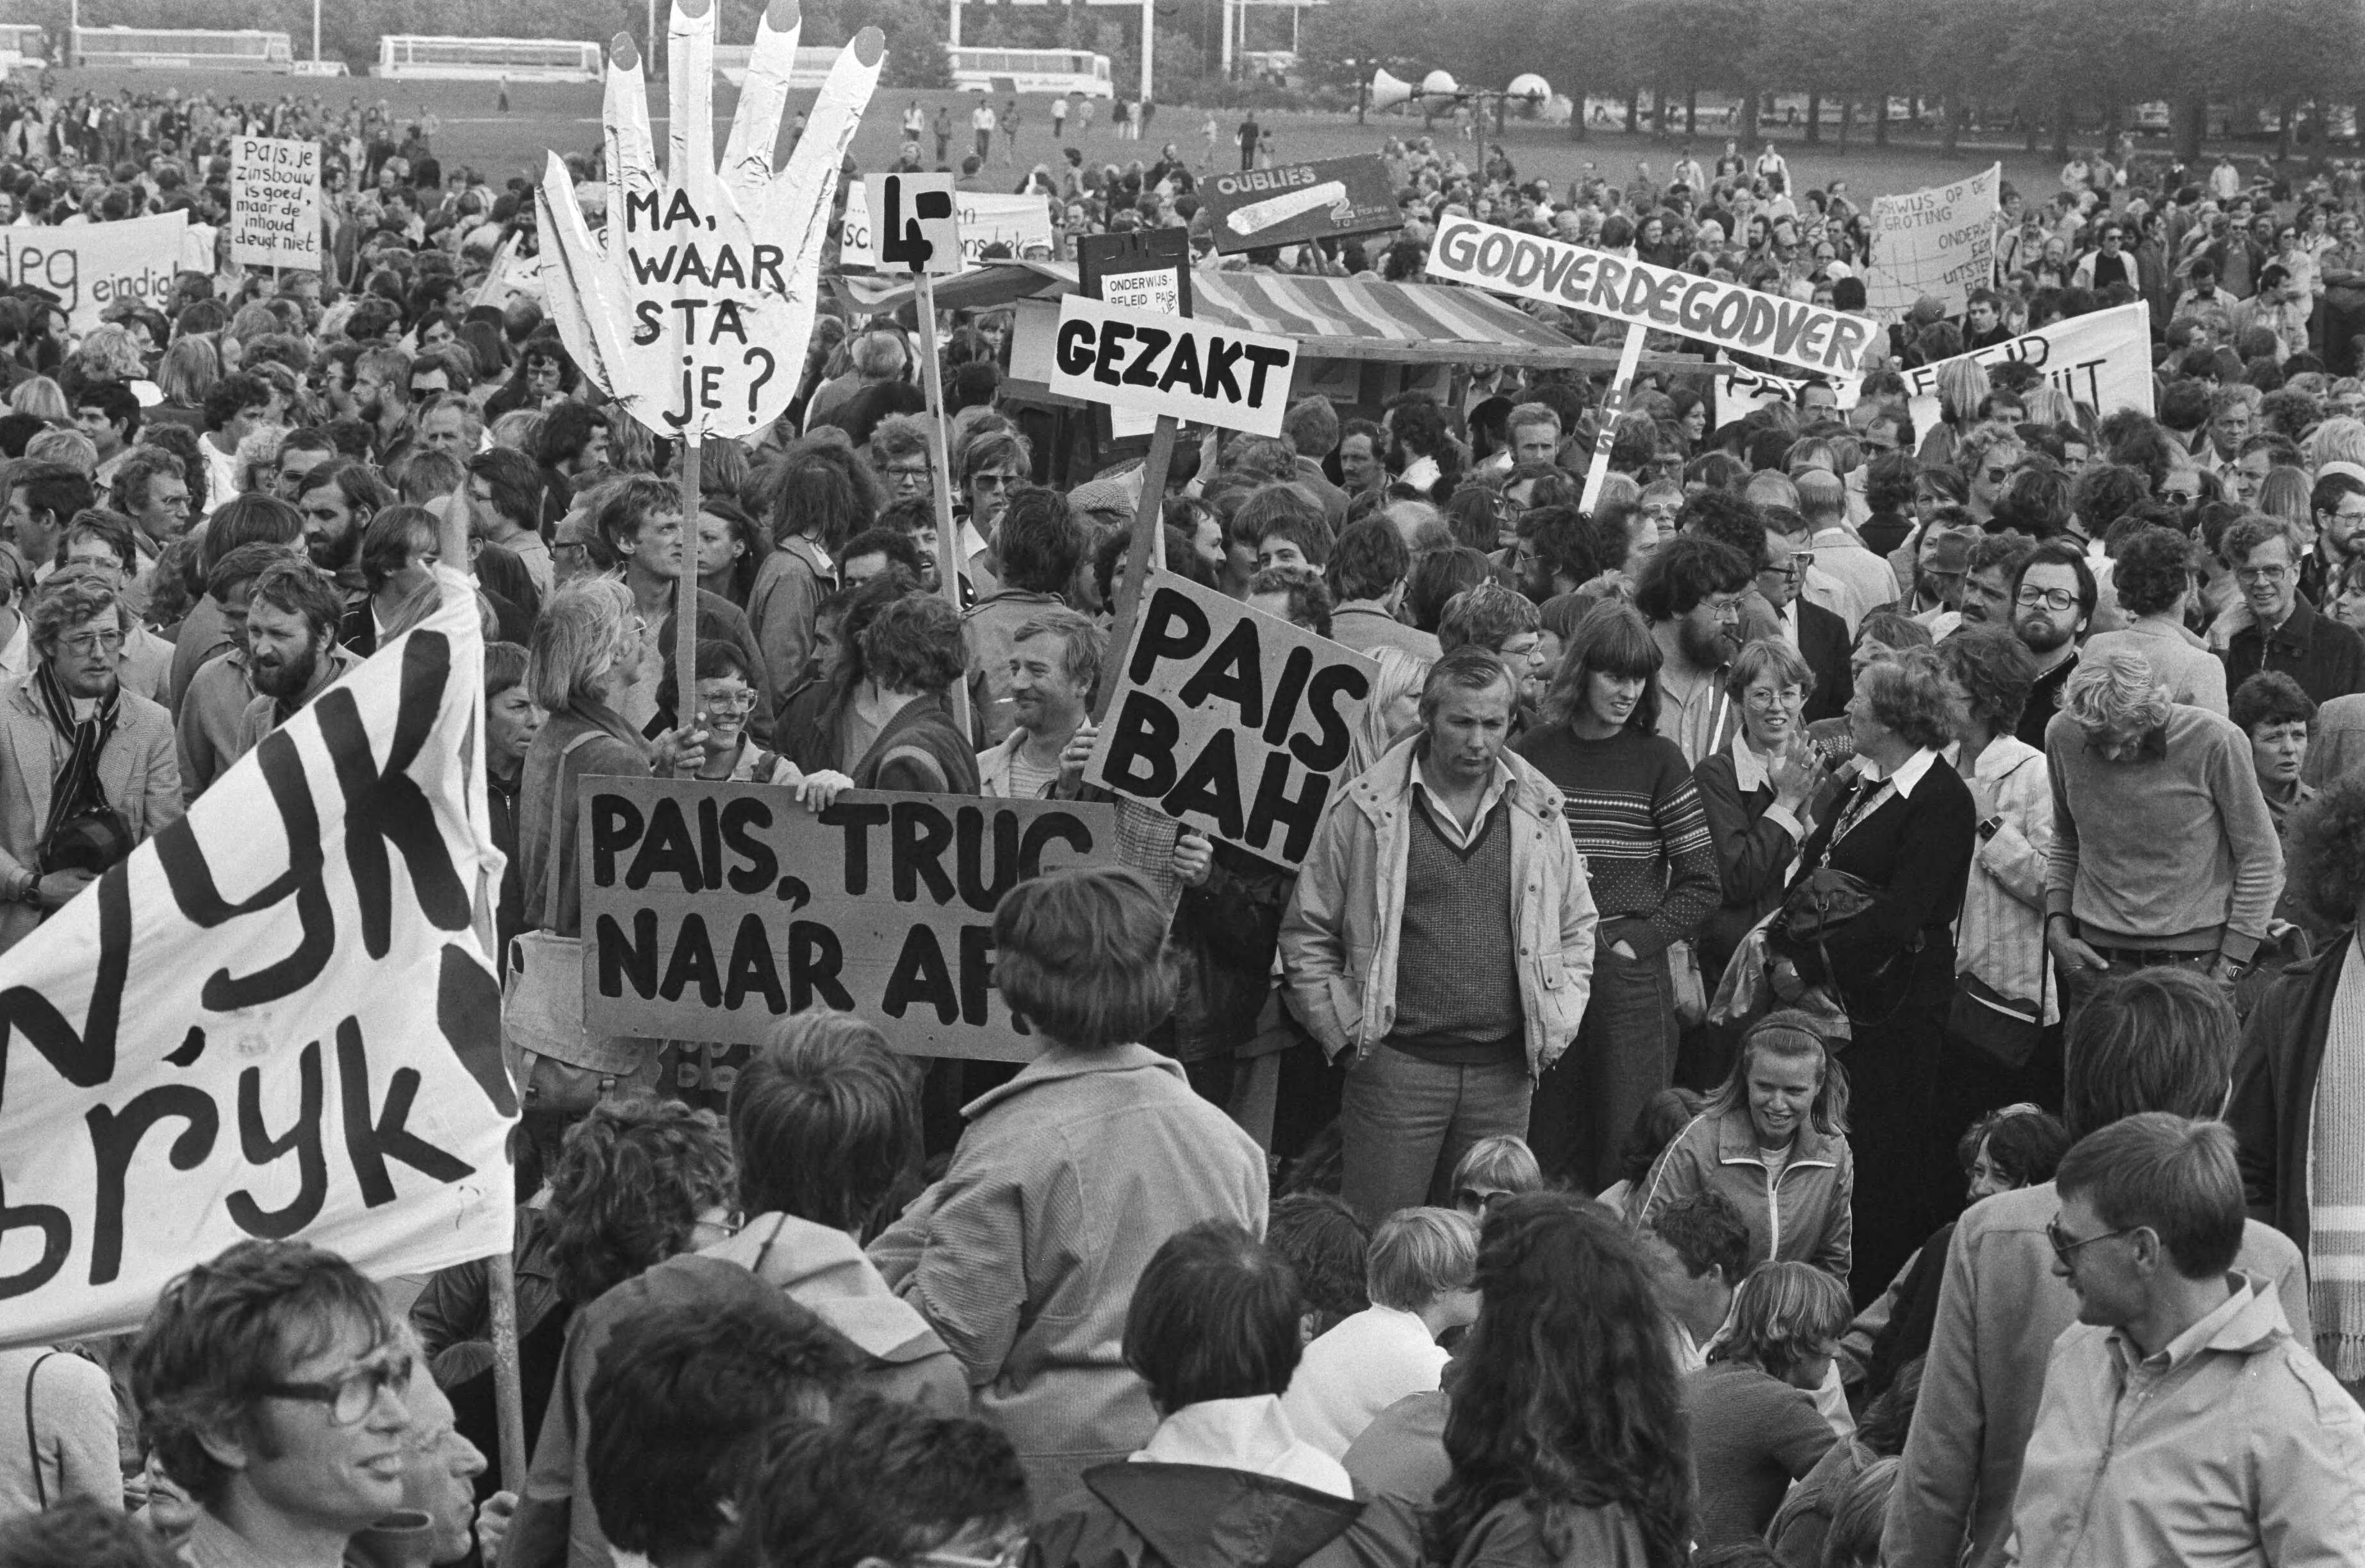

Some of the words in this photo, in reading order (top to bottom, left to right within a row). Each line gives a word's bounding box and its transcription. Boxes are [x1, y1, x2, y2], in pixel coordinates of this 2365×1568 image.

[236, 162, 315, 186] zinsbouw
[297, 145, 313, 168] je
[244, 182, 260, 198] is
[1217, 165, 1317, 195] OUBLIES
[1945, 186, 1963, 204] OP
[236, 200, 278, 214] maar
[281, 202, 301, 217] de
[244, 213, 295, 233] inhoud
[626, 188, 716, 233] MA,
[234, 227, 278, 250] deugt
[627, 242, 788, 295] WAAR
[1439, 224, 1865, 372] GODVERDEGODVER
[634, 298, 748, 346] STA
[1056, 318, 1290, 409] GEZAKT
[1128, 586, 1370, 772] PAIS
[1101, 689, 1331, 865] BAH
[591, 793, 811, 913] PAIS,
[596, 907, 856, 1016] NAAR
